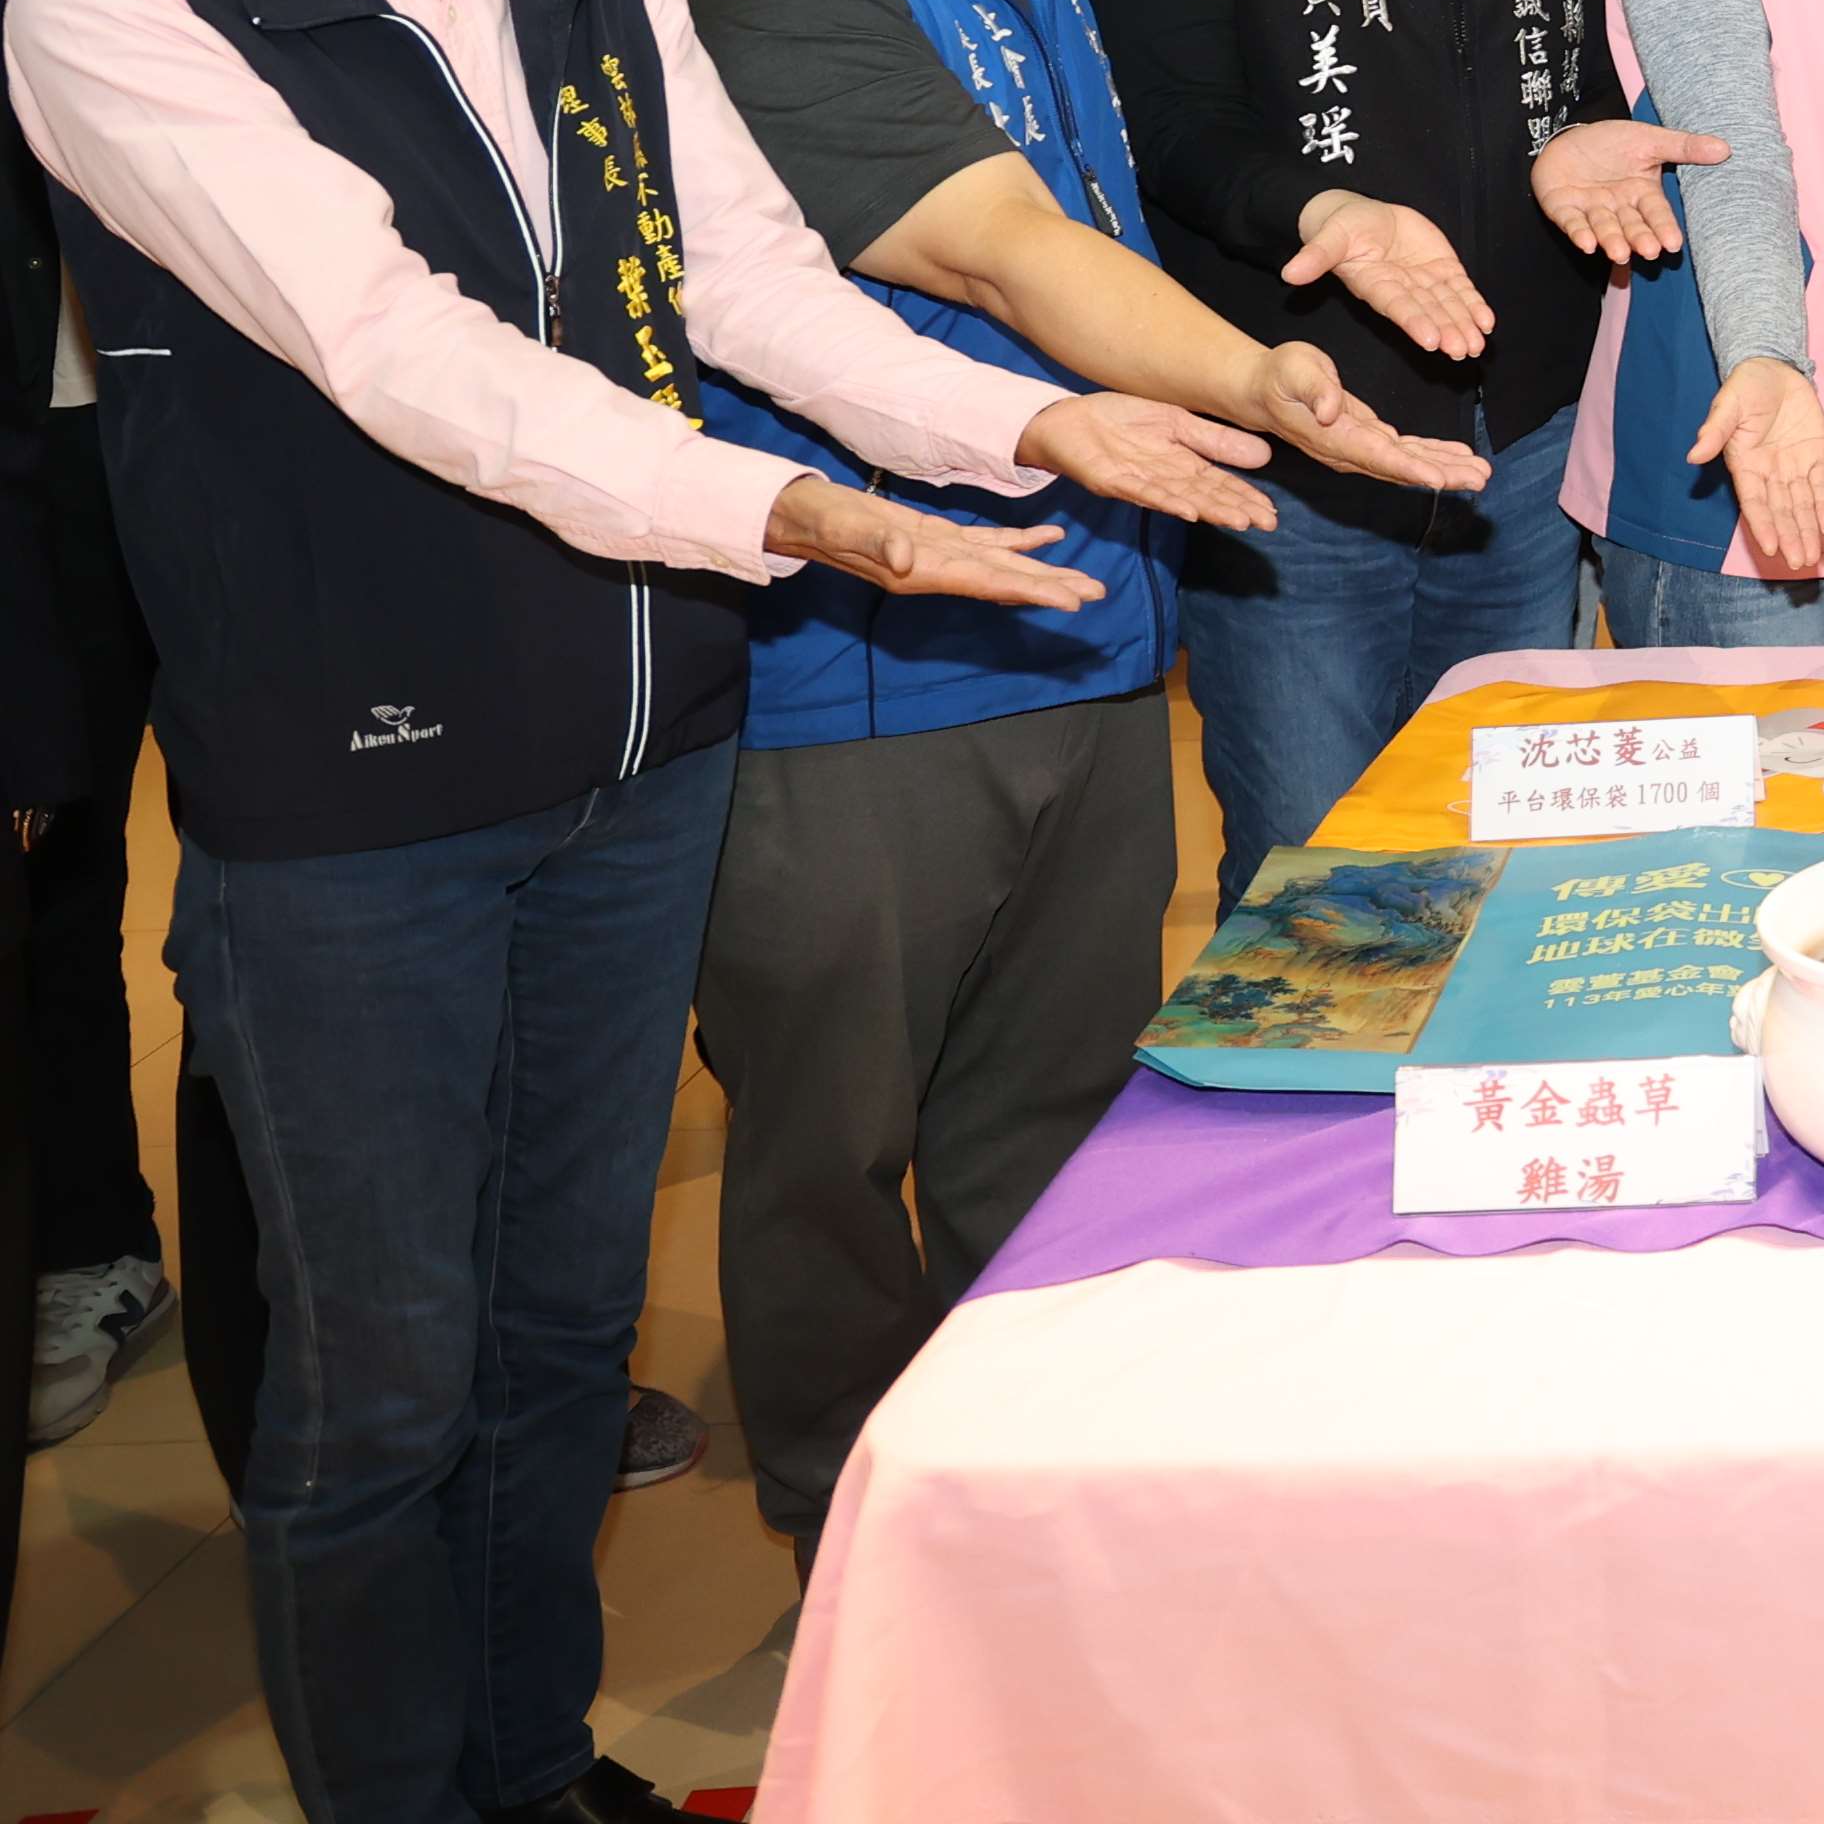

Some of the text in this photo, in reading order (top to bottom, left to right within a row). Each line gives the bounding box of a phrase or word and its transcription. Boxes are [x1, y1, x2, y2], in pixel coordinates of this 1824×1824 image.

[560, 85, 628, 193] 理事長
[1497, 780, 1721, 815] 平台環保袋 1700 個
[1551, 862, 1711, 901] 傳愛
[1536, 900, 1760, 938] 環保袋出
[1463, 1073, 1680, 1133] 黃金蟲草
[1515, 1154, 1625, 1205] 雞湯
